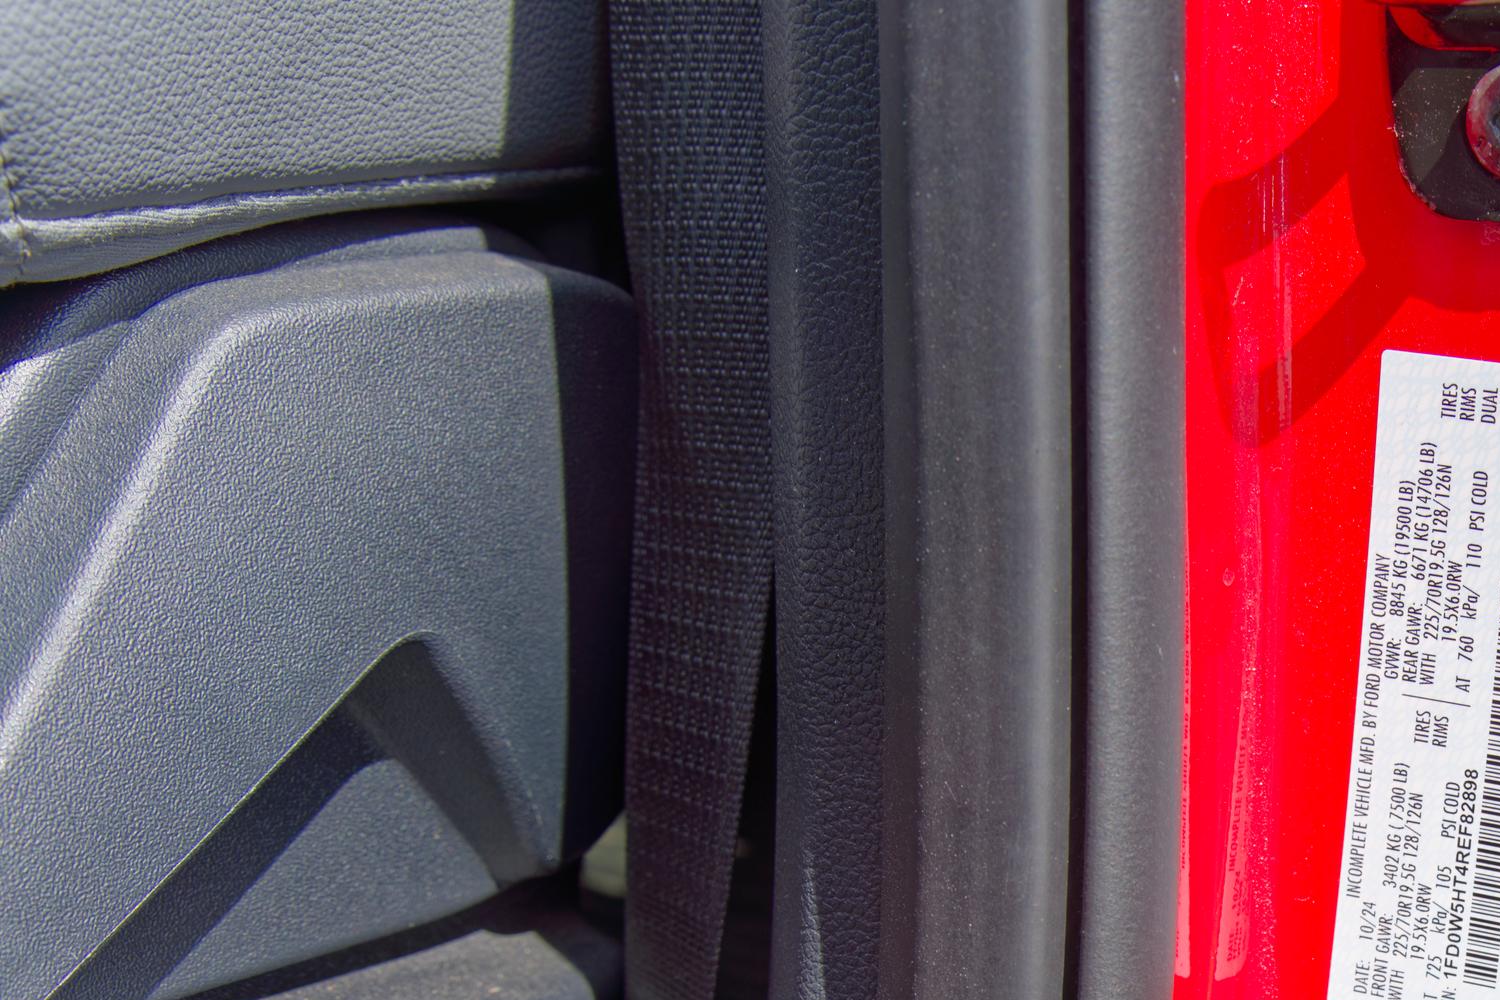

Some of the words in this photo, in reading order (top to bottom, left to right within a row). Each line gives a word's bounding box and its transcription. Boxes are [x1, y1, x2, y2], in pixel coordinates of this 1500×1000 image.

[1440, 383, 1458, 418] TIRES
[1480, 388, 1499, 424] DUAL
[1419, 442, 1437, 464] LB)
[1398, 480, 1416, 502] LB)
[1415, 469, 1434, 518] (14706
[1432, 464, 1452, 533] 128/126N
[1471, 471, 1488, 505] COLD
[1394, 506, 1412, 555] (19500
[1441, 560, 1463, 641] 19.5X6.0RW
[1459, 387, 1477, 421] RIMS
[1469, 510, 1485, 531] PSI
[1413, 522, 1429, 541] KG
[1392, 560, 1408, 578] KG
[1410, 547, 1427, 581] 6671
[1466, 543, 1482, 568] 110
[1371, 553, 1390, 618] COMPANY
[1389, 582, 1406, 617] 8845
[1423, 539, 1446, 640] 225/70R19.5G
[1460, 585, 1480, 620] kPa/
[1405, 602, 1423, 646] GAWR:
[1367, 622, 1385, 669] MOTOR
[1384, 638, 1401, 679] GVWR:
[1457, 636, 1474, 662] 760
[1402, 650, 1419, 683] REAR
[1419, 653, 1436, 685] WITH
[1363, 673, 1381, 708] FORD
[1455, 675, 1470, 693] AT
[1362, 711, 1377, 728] BY
[1414, 710, 1431, 743] TIRES
[1359, 734, 1376, 765] MFD.
[1393, 763, 1410, 783] LB)
[1354, 768, 1372, 817] VEHICLE
[1443, 782, 1460, 815] COLD
[1403, 792, 1423, 857] 128/126N
[1410, 883, 1432, 960] 19.5X6.0RW
[1432, 715, 1449, 748] RIMS
[1441, 819, 1457, 839] PSI
[1346, 822, 1367, 898] INCOMPLETE
[1386, 834, 1402, 852] KG
[1382, 855, 1399, 888] 3402
[1435, 865, 1452, 889] 105
[1443, 769, 1479, 979] 1FD0W5HT4REF82898
[1359, 901, 1376, 940] 10/24
[1392, 863, 1416, 958] 225/70R19.5G
[1430, 901, 1451, 934] kPa/
[1375, 914, 1393, 954] GAWR:
[1353, 960, 1370, 994] DATE:
[1370, 957, 1388, 998] FRONT
[1388, 969, 1404, 1000] WITH
[1425, 955, 1442, 980] 725
